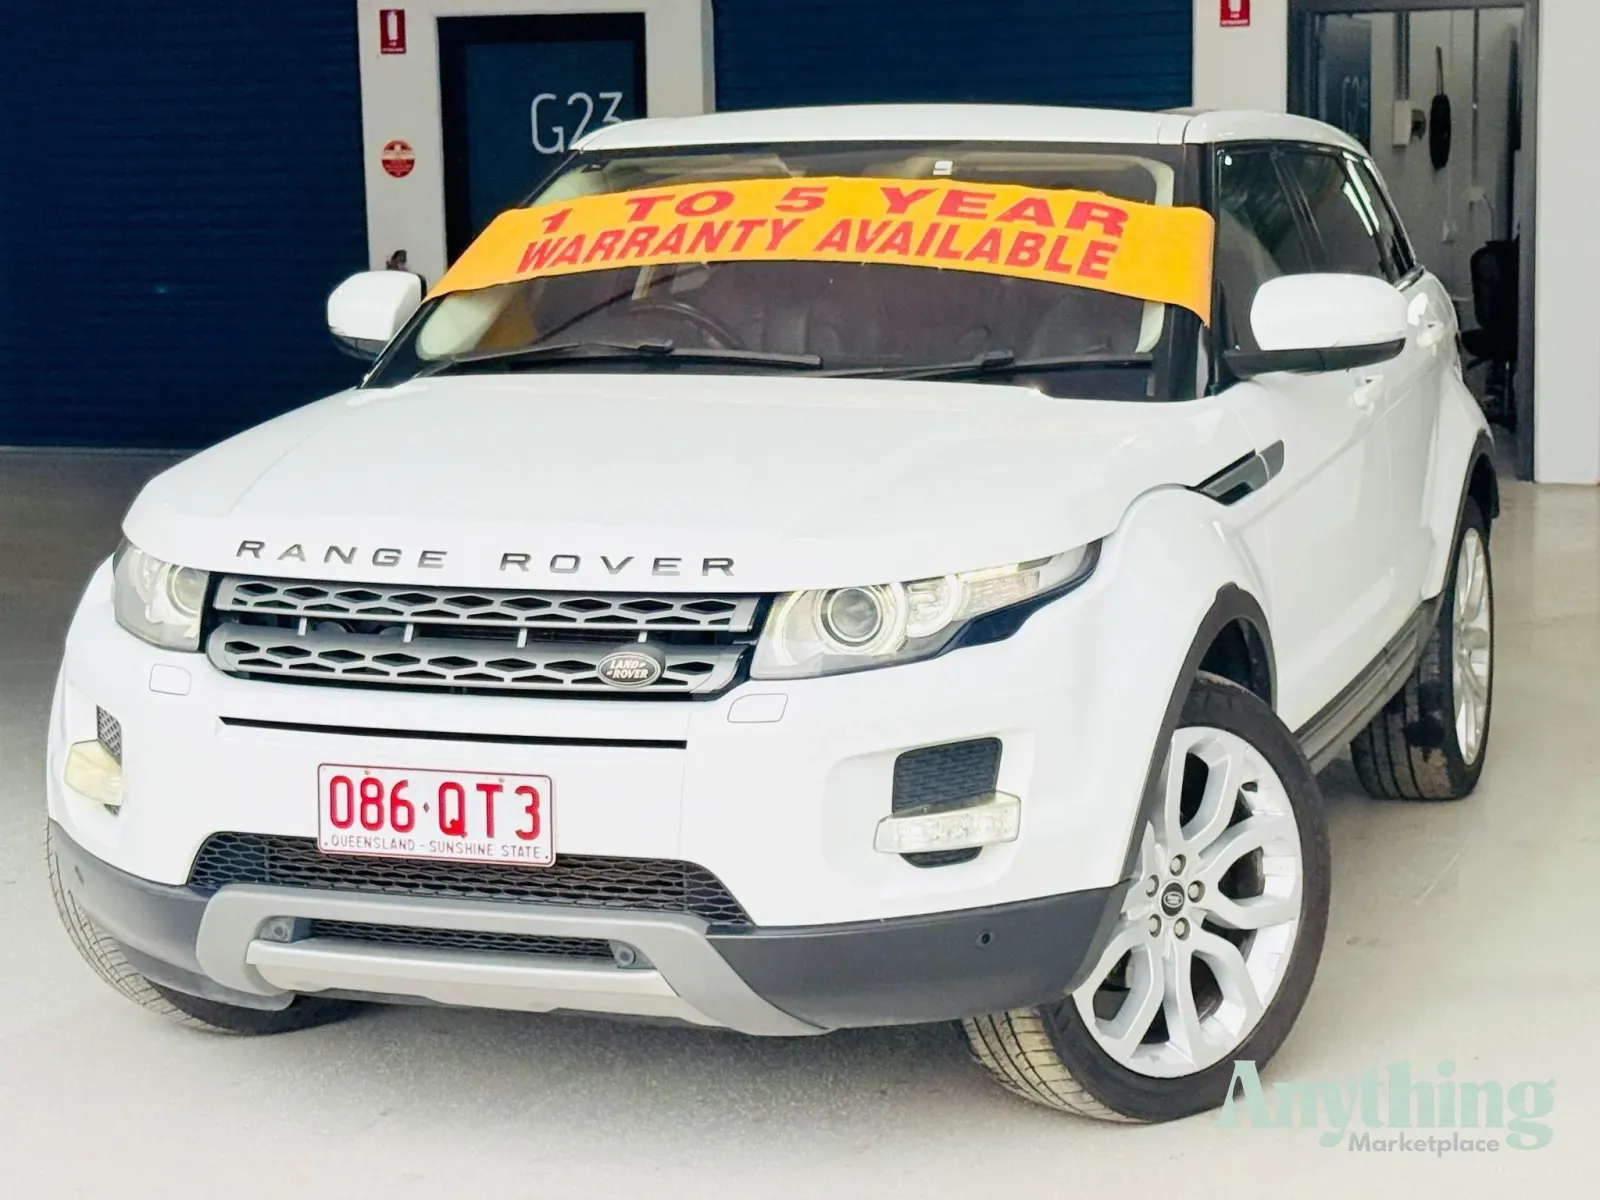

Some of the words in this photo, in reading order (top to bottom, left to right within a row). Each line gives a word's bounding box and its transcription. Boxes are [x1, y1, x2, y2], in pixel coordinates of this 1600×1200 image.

[543, 212, 576, 237] 1
[625, 189, 734, 221] TO
[774, 188, 826, 211] 5
[880, 188, 1128, 237] YEAR
[517, 220, 800, 273] WARRANTY
[816, 220, 1118, 280] AVAILABLE
[236, 539, 448, 569] RANGE
[500, 552, 735, 577] ROVER
[329, 775, 415, 833] 086
[438, 781, 541, 841] QT3
[331, 834, 415, 851] QUEENSLAND
[429, 840, 494, 857] SUNSHINE
[501, 845, 541, 859] STATE
